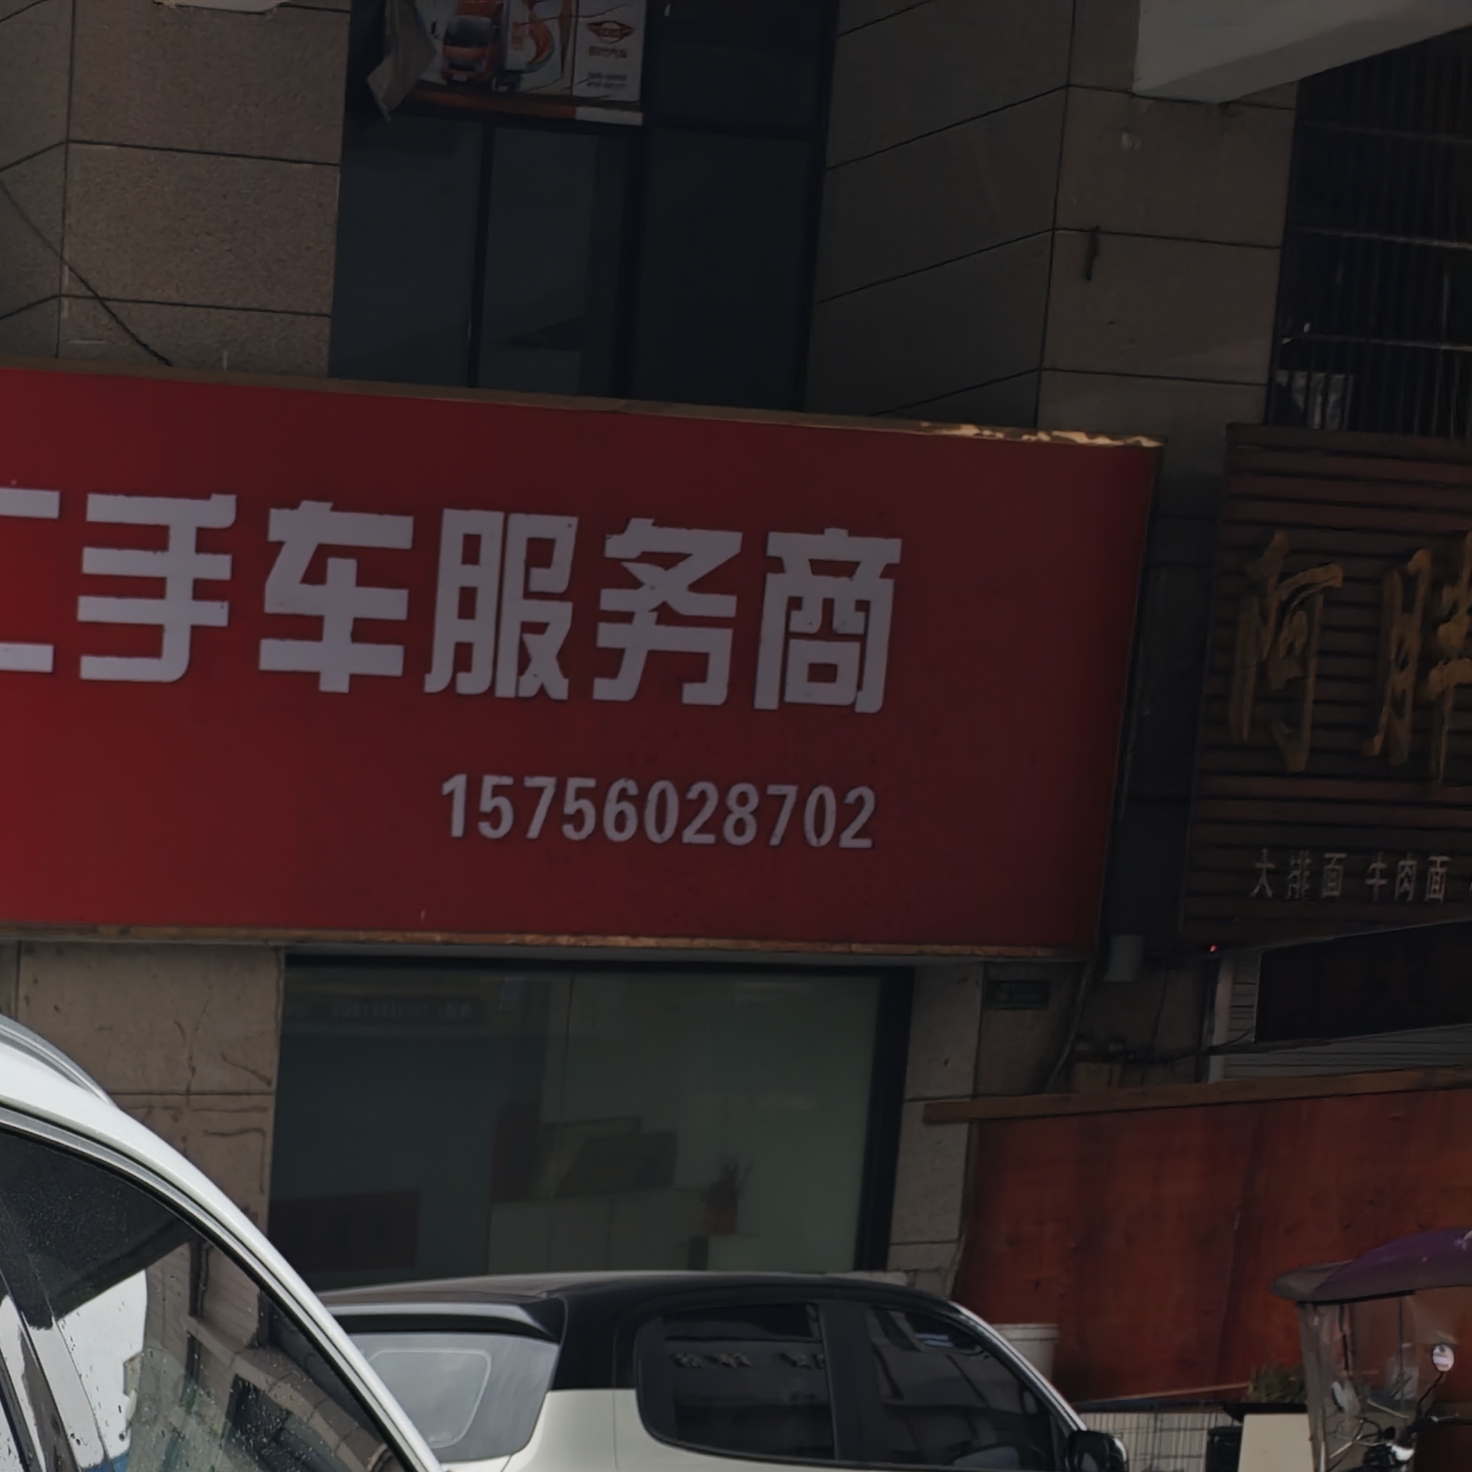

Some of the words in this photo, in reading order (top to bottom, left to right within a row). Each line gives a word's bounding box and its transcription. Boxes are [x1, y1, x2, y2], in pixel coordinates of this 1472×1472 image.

[441, 773, 878, 849] 15756028702
[1365, 853, 1450, 904] 牛肉面
